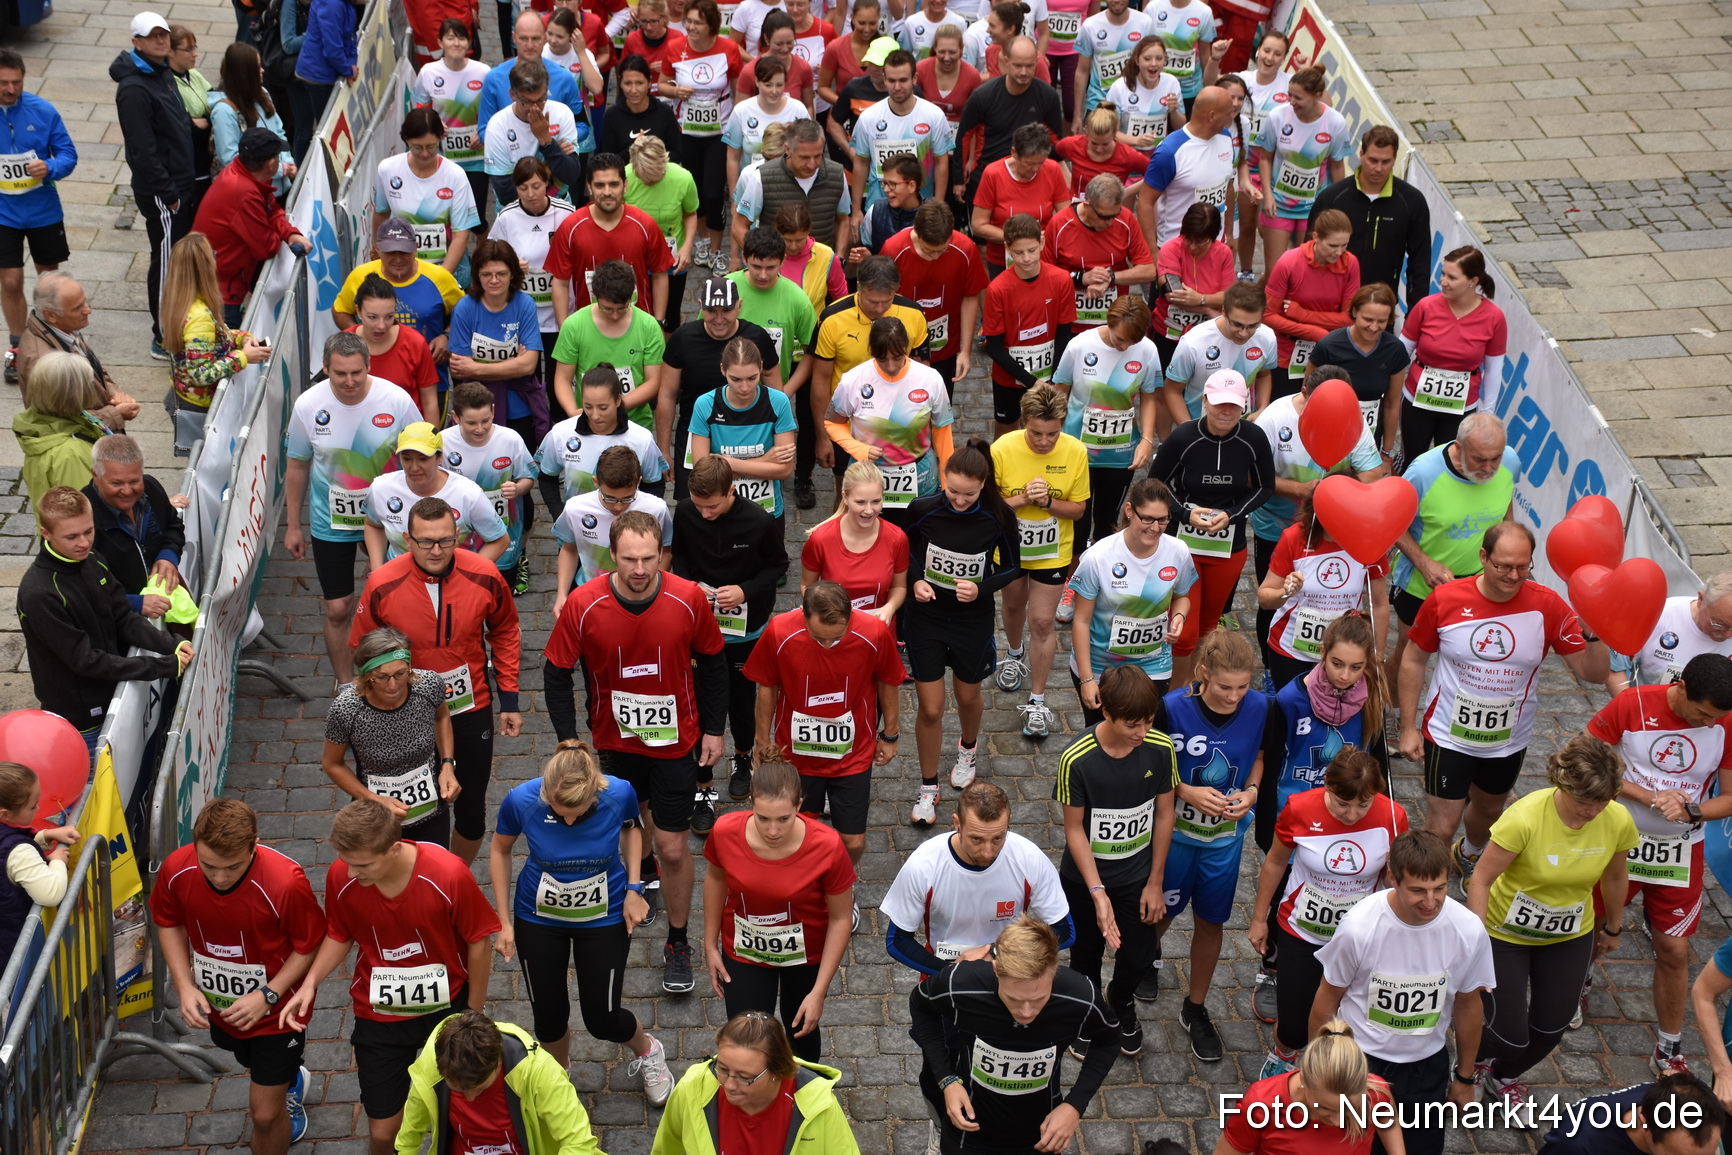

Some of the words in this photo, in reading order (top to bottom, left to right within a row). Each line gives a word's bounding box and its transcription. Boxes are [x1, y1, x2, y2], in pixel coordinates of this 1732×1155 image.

[1049, 18, 1077, 31] 5076
[686, 108, 718, 122] 5039
[1132, 123, 1164, 137] 5115
[1282, 170, 1316, 190] 5078
[1075, 294, 1114, 309] 5065
[477, 345, 518, 360] 5104
[1028, 347, 1049, 355] Neumarkt
[1422, 378, 1465, 398] 5152
[1426, 396, 1453, 407] Katarina
[1088, 417, 1128, 435] 5117
[720, 444, 764, 455] HUBER
[331, 490, 347, 498] PARTL
[928, 548, 948, 560] PARTL
[949, 554, 976, 562] Neumarkt
[931, 557, 980, 577] 5339
[1136, 619, 1161, 627] Neumarkt
[1299, 612, 1316, 620] PARTL
[1117, 625, 1163, 645] 5053
[1129, 646, 1145, 654] Lisa
[1654, 650, 1674, 659] PARTL
[1453, 660, 1481, 673] LAUFEN
[613, 695, 633, 704] PARTL
[1456, 695, 1475, 706] PARTL
[619, 704, 671, 727] 5129
[1458, 705, 1509, 729] 5161
[1296, 717, 1311, 735] B
[798, 724, 851, 743] 5100
[1464, 731, 1498, 741] Andreas
[811, 744, 838, 753] Daniel
[369, 779, 390, 788] PARTL
[391, 773, 421, 787] Neumarkt
[1661, 779, 1677, 788] MIT
[1680, 782, 1701, 790] HERZ
[1093, 812, 1116, 820] PARTL
[1117, 808, 1146, 819] Neumarkt
[1098, 814, 1148, 841] 5202
[1110, 841, 1137, 853] Adrian
[1629, 865, 1675, 877] Johannes
[542, 878, 561, 892] PARTL
[563, 881, 596, 892] Neumarkt
[544, 886, 602, 908] 5324
[1304, 888, 1324, 902] PARTL
[1326, 898, 1358, 908] Neumarkt
[1516, 895, 1540, 910] PARTL
[1541, 908, 1574, 916] Neumarkt
[1515, 905, 1575, 933] 5150
[756, 929, 791, 937] Neumarkt
[741, 930, 798, 953] 5094
[392, 948, 411, 958] DEHN
[938, 946, 962, 956] PARTL
[195, 959, 217, 971] PARTL
[219, 966, 252, 975] Neumarkt
[201, 968, 260, 994] 5062
[398, 972, 435, 981] Neumarkt
[1372, 977, 1398, 989] PARTL
[1400, 981, 1436, 989] Neumarkt
[379, 981, 439, 1006] 5141
[1377, 989, 1439, 1014] 5021
[1388, 1016, 1425, 1027] Johann
[976, 1043, 1001, 1060] PARTL
[980, 1054, 1046, 1079] 5148
[986, 1076, 1033, 1090] Christian
